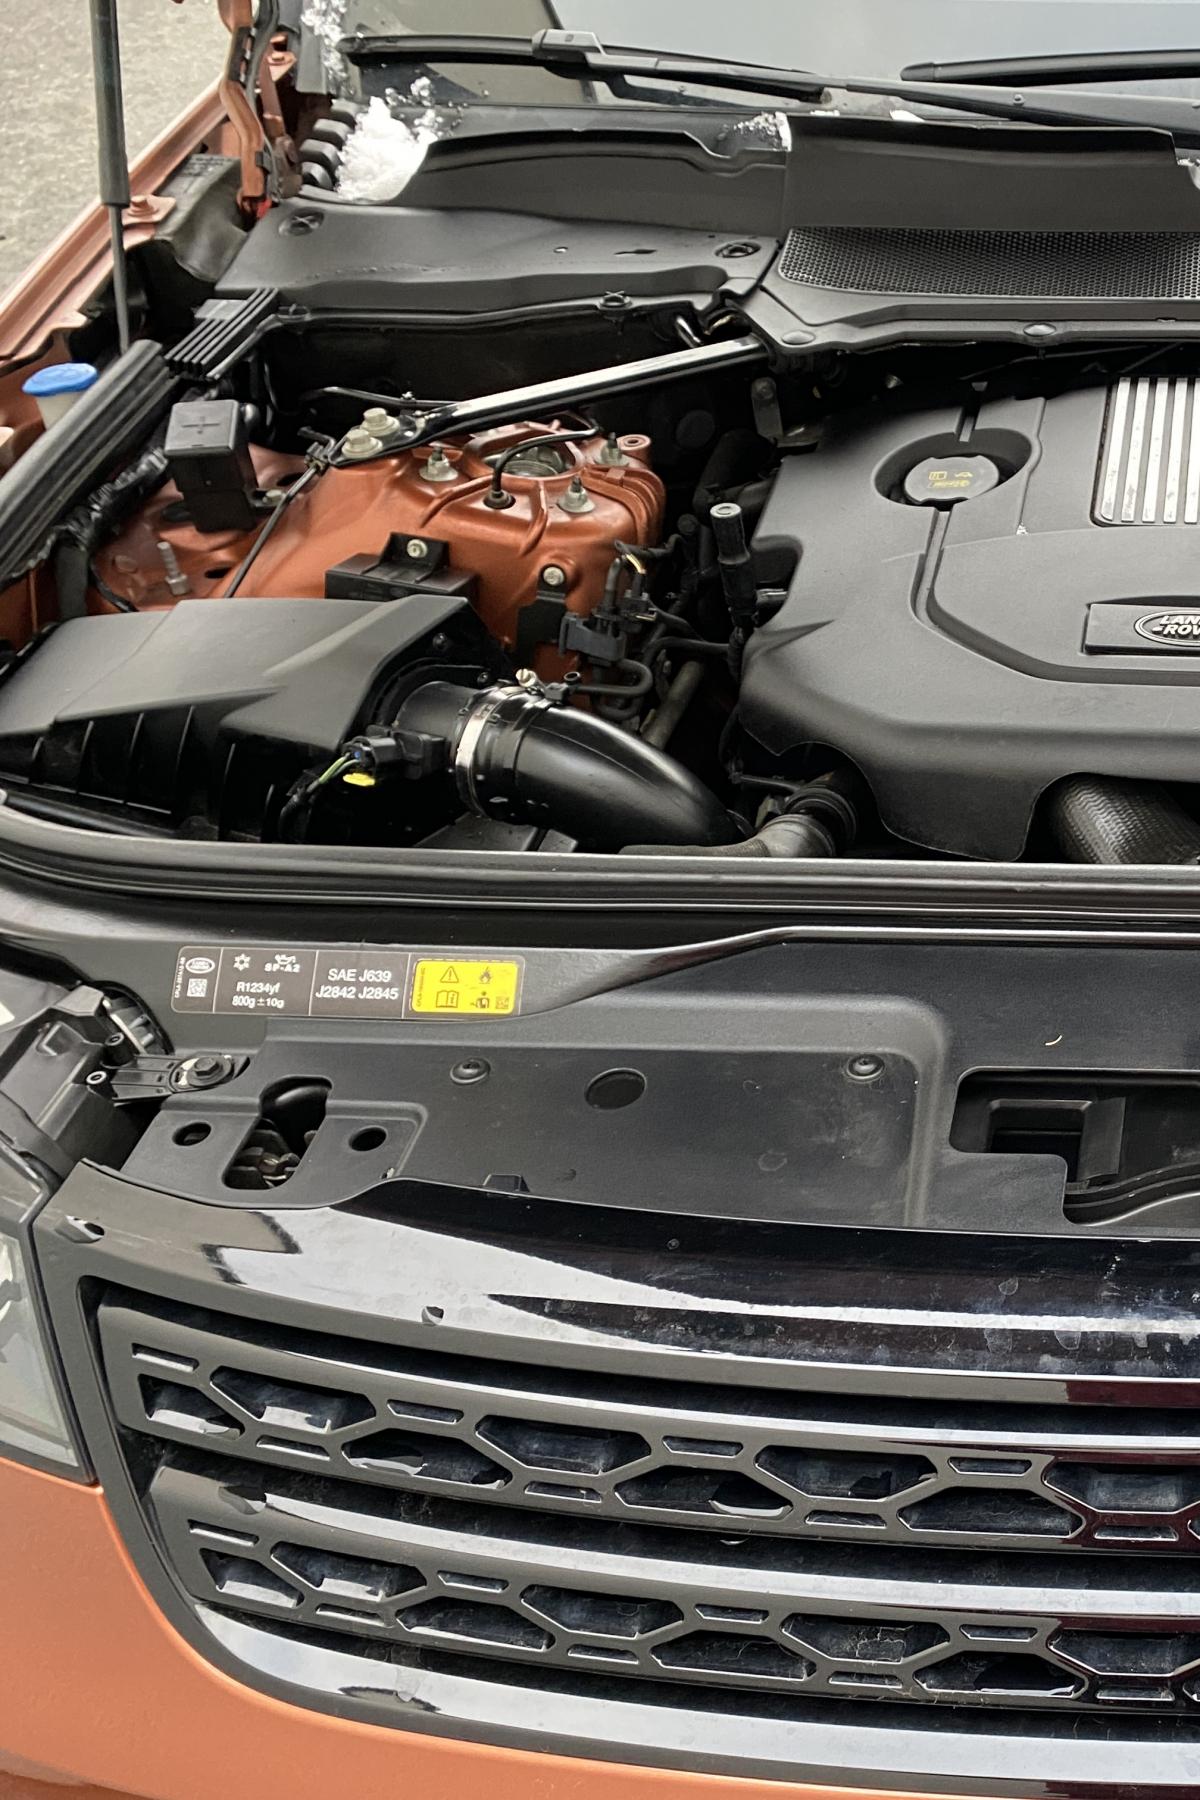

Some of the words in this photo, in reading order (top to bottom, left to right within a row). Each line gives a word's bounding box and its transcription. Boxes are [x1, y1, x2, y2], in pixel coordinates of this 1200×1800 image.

[328, 968, 357, 982] SAE
[358, 969, 392, 983] J639
[236, 981, 281, 995] R1234yf
[315, 985, 356, 999] J2842
[358, 986, 399, 1000] J2845
[232, 995, 256, 1008] 800g
